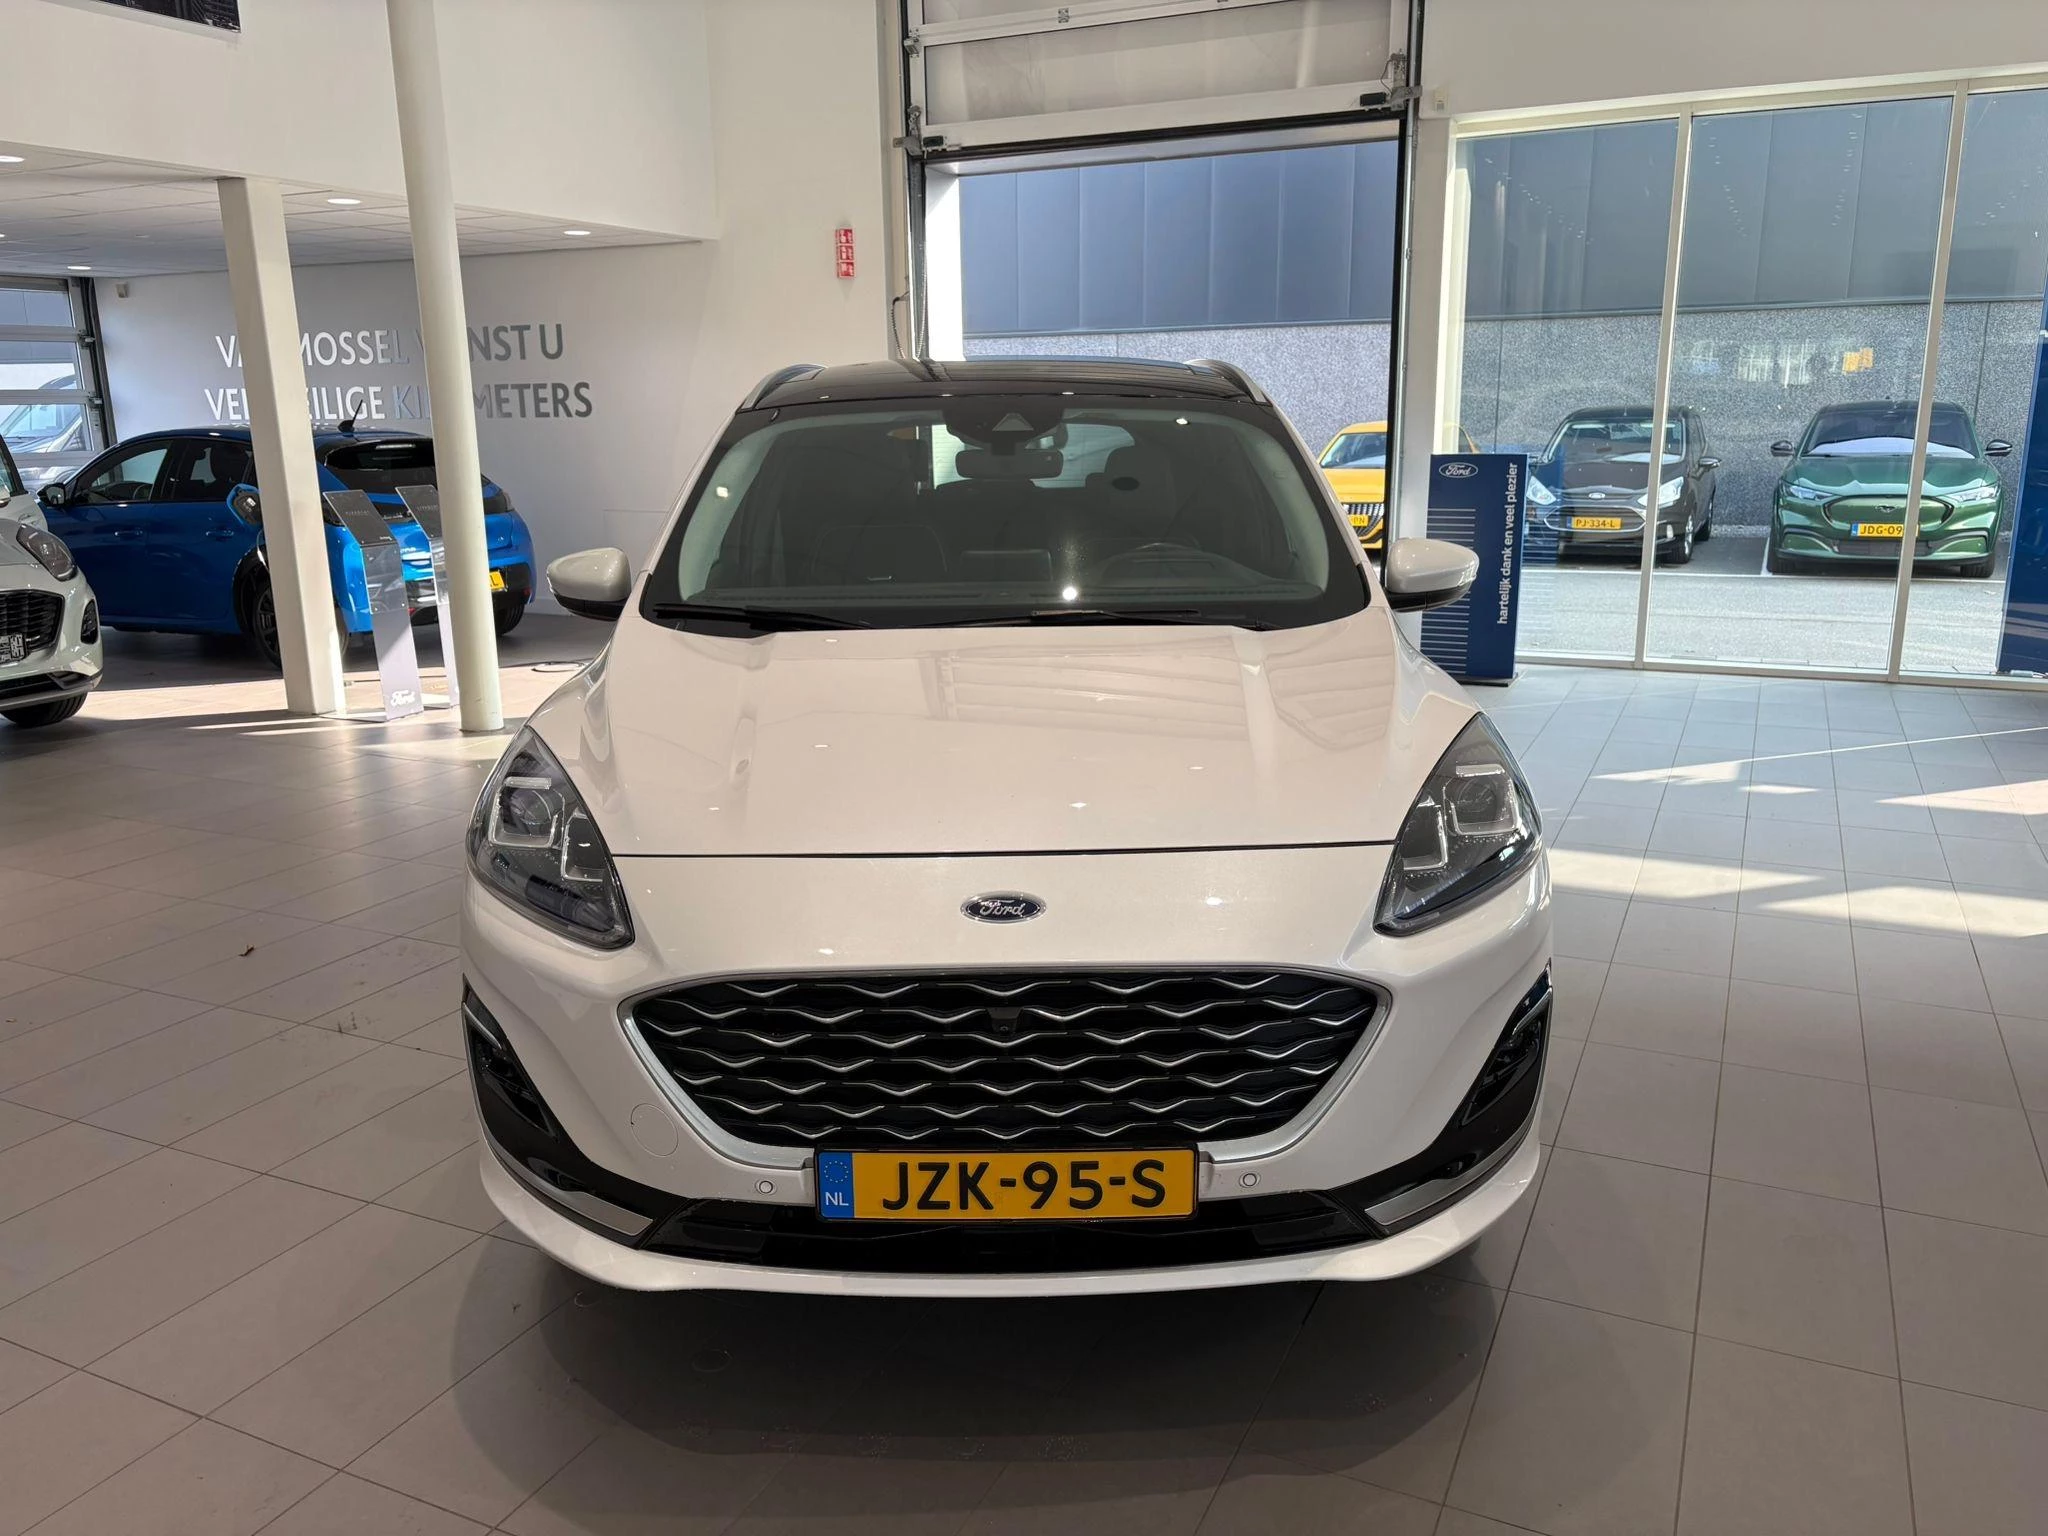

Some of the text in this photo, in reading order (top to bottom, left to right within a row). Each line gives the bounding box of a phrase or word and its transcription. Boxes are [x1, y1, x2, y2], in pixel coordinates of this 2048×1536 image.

[538, 322, 564, 361] U
[1575, 518, 1616, 529] PJ-334-L
[1860, 524, 1905, 535] JDG-09
[1497, 462, 1518, 625] hartelijk dank en veel plezier
[825, 1158, 1167, 1211] NL JZK-95-S
